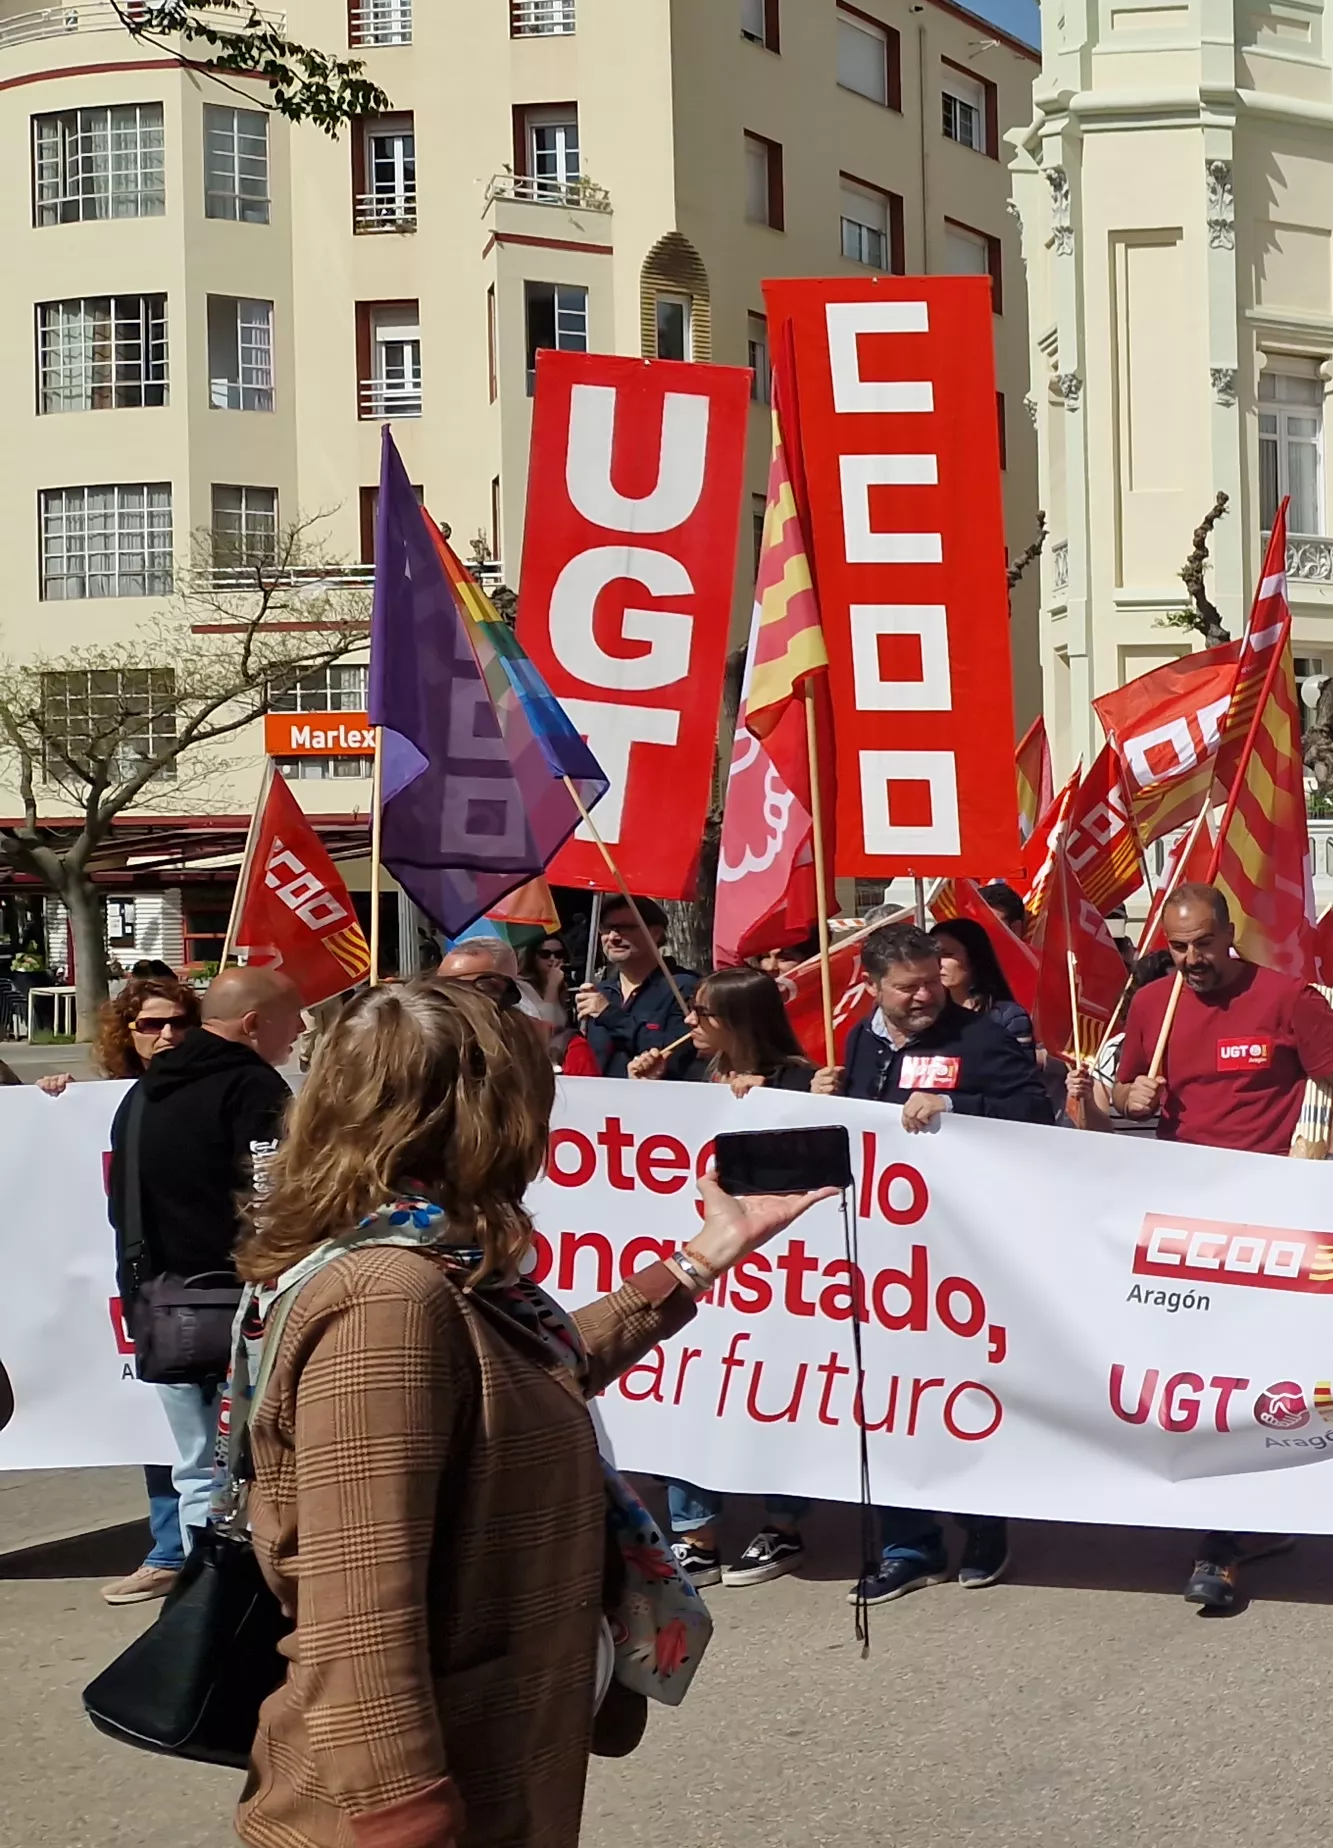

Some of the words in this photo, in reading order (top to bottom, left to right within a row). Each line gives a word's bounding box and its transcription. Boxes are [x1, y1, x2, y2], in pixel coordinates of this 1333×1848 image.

[825, 301, 961, 855] CCOO
[549, 384, 709, 844] UGT
[291, 725, 376, 749] Marlex
[1220, 1045, 1249, 1059] UGT
[859, 1131, 929, 1226] lo
[1145, 1227, 1307, 1279] CCOO
[1126, 1283, 1212, 1312] Aragón
[716, 1332, 1003, 1442] futuro
[1109, 1362, 1250, 1433] UGT
